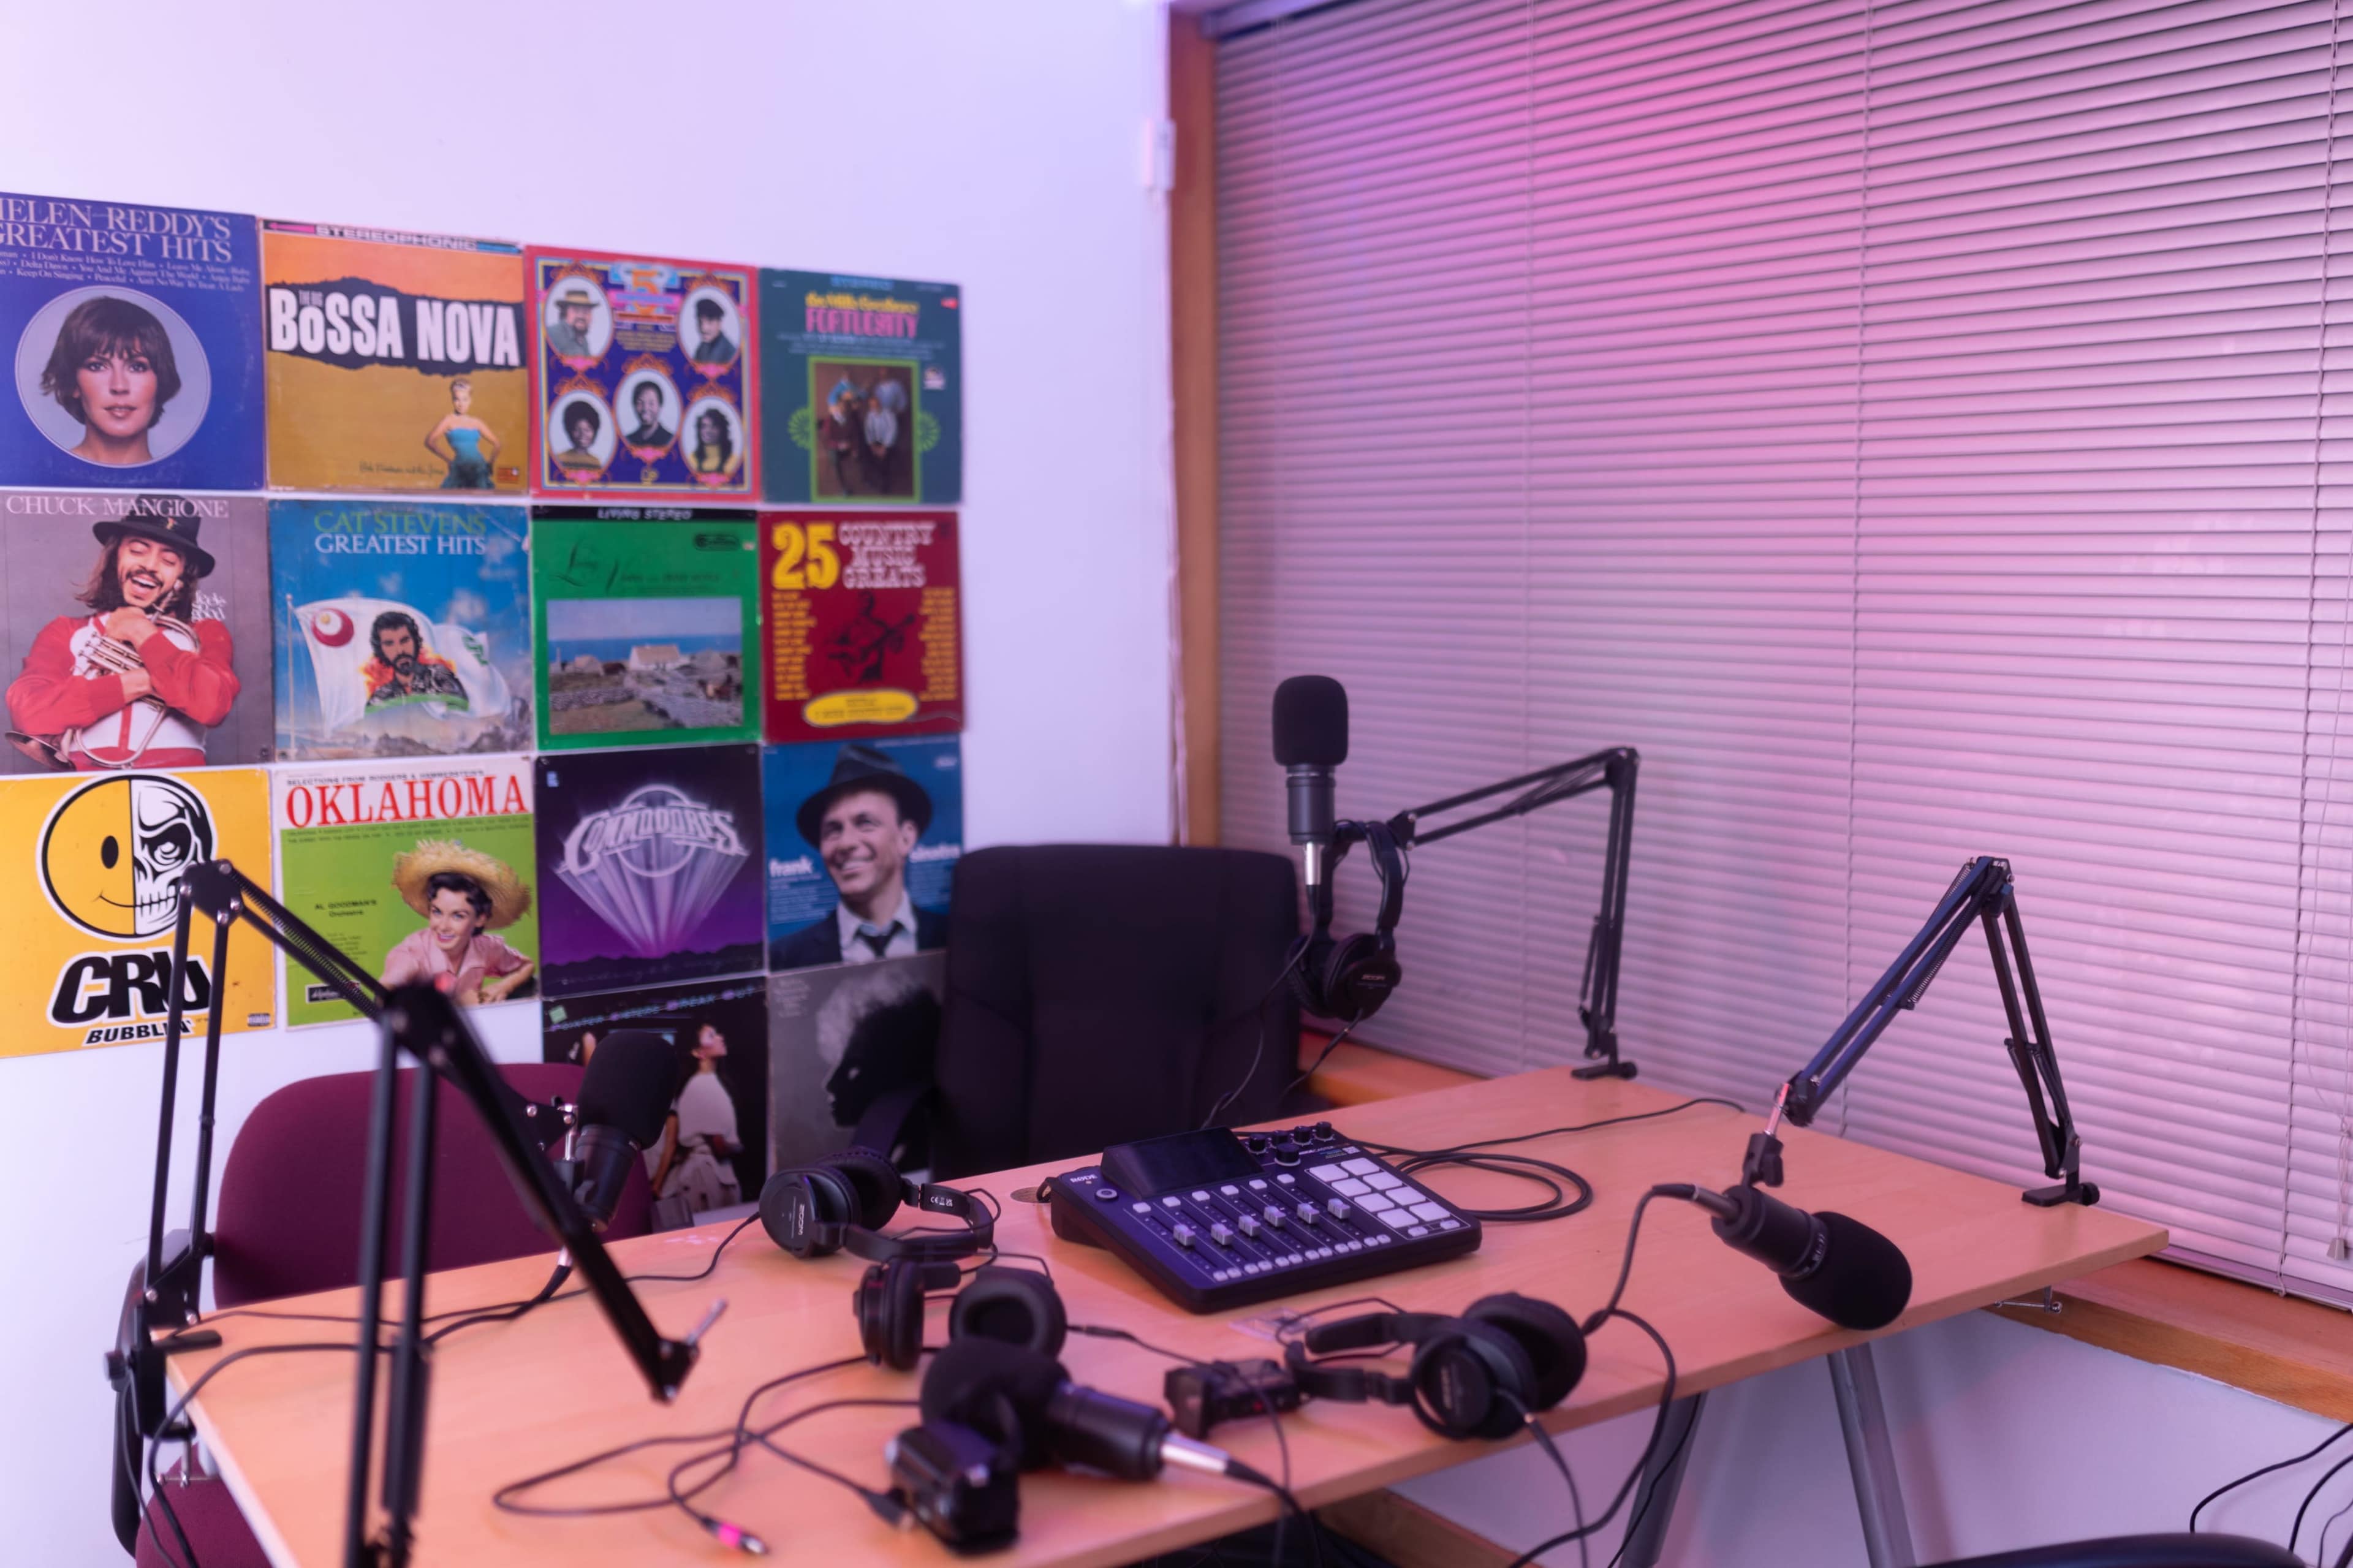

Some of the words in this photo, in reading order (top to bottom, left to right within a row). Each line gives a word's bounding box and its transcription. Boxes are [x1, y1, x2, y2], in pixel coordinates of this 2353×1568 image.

[107, 207, 231, 240] REDDY'S
[161, 235, 232, 263] HITS
[316, 224, 477, 251] STEREOPHONIC
[415, 299, 520, 366] NOVA
[6, 496, 95, 515] CHUCK
[103, 498, 229, 518] MANGIONE
[597, 508, 641, 520] LIVING
[644, 509, 692, 520] STEREO
[314, 510, 366, 533] CAT
[374, 513, 486, 535] STEVENS
[838, 521, 936, 547] COUNTRY
[314, 533, 430, 555] GREATEST
[438, 536, 486, 555] HITS
[772, 521, 840, 590] 25
[286, 775, 529, 828] OKLAHOMA
[556, 805, 750, 876] COMMODORES
